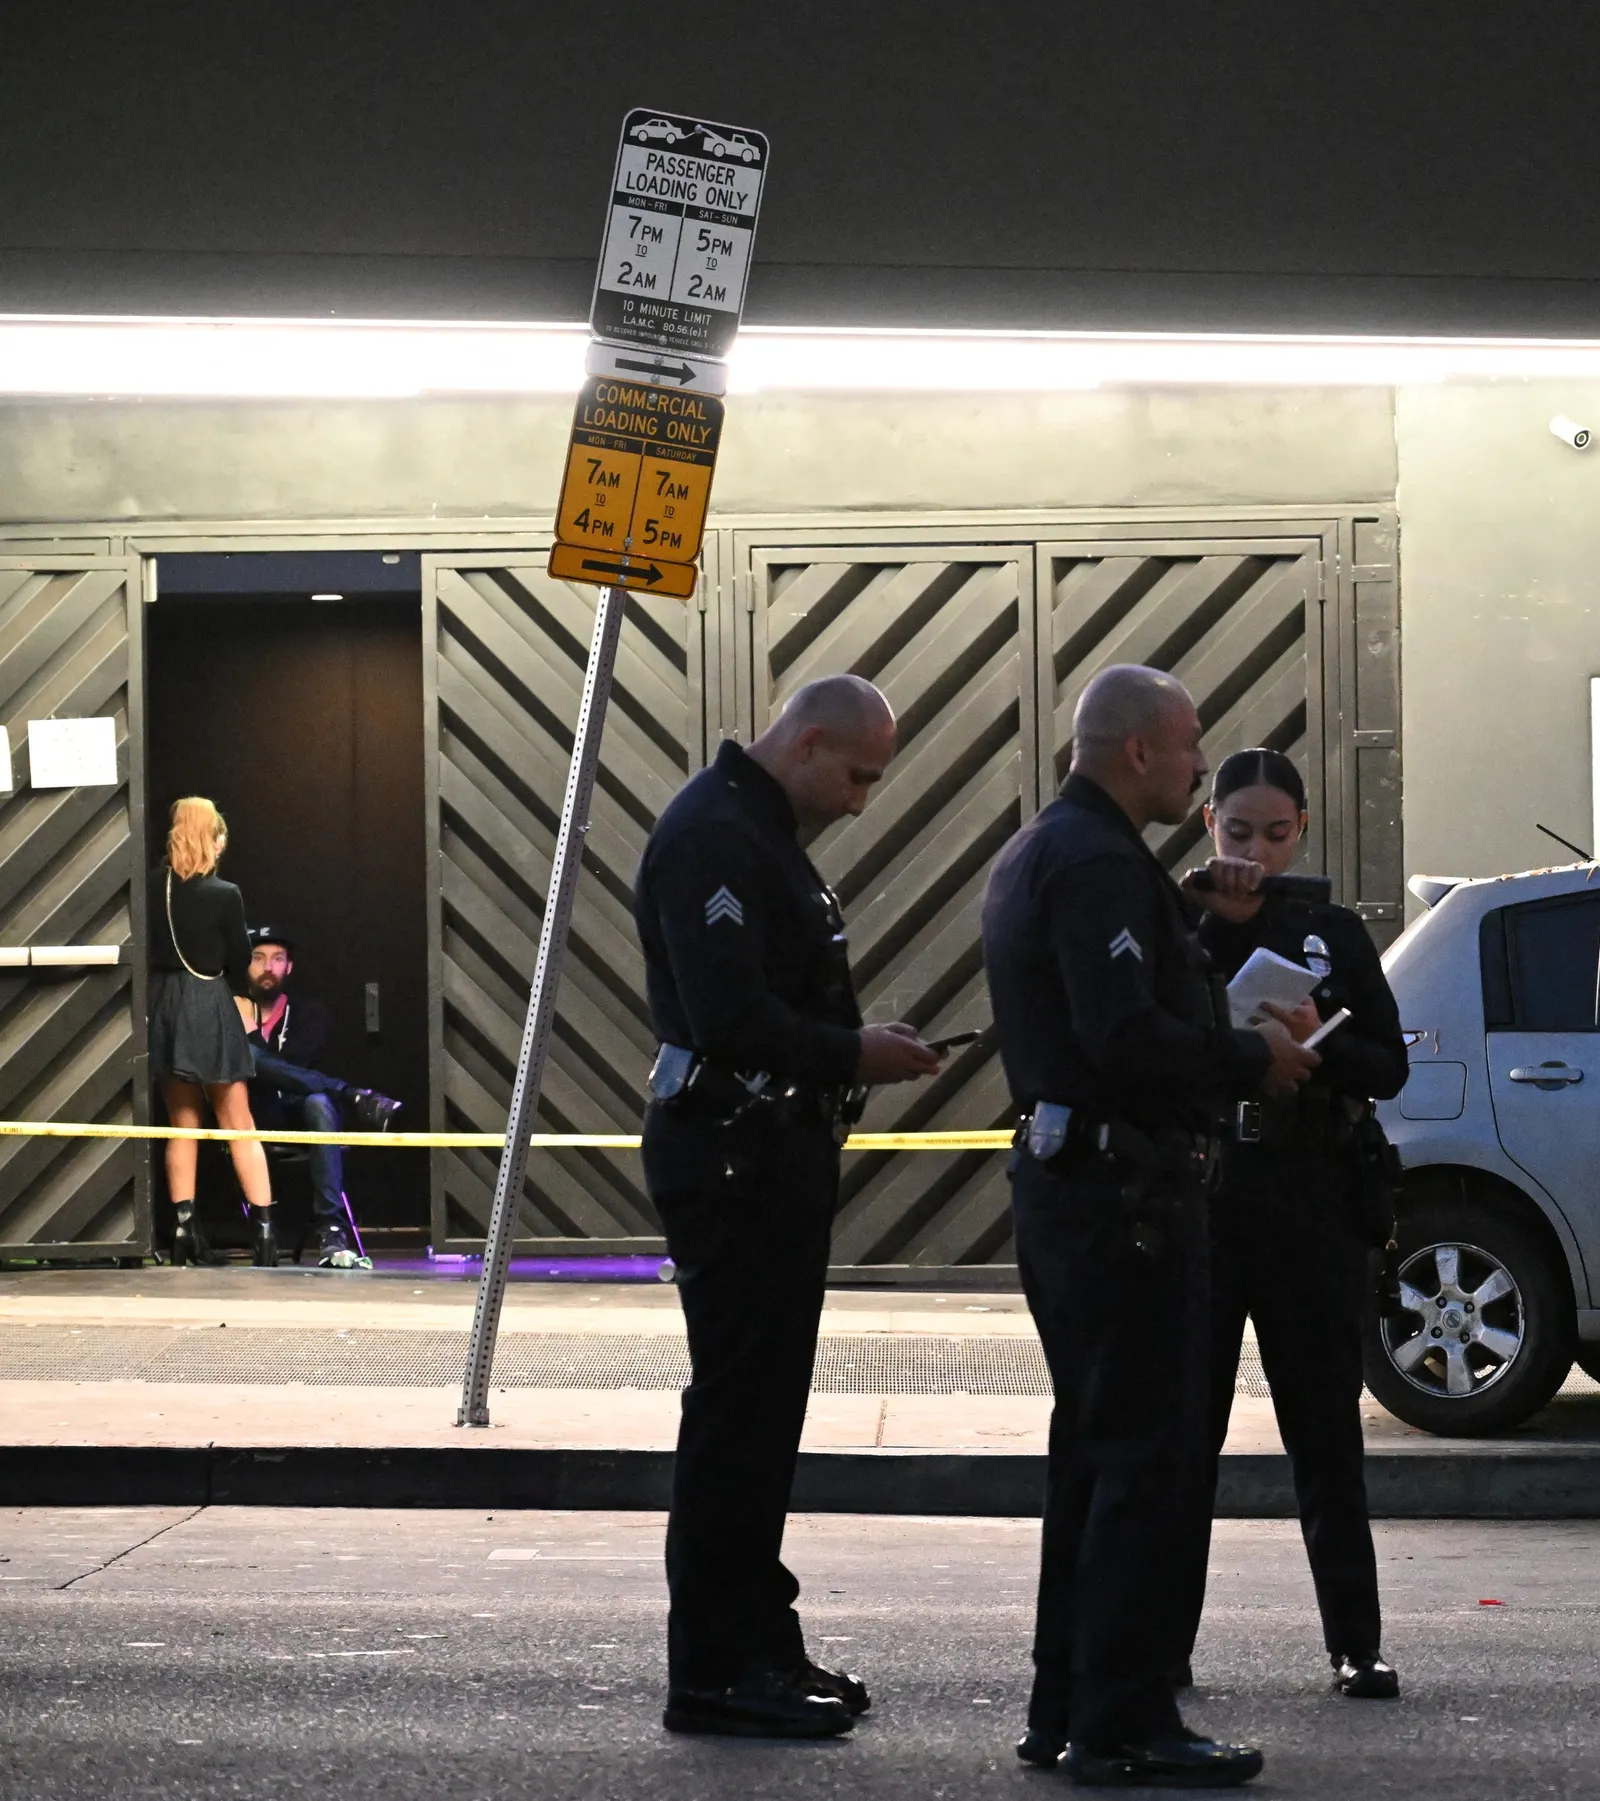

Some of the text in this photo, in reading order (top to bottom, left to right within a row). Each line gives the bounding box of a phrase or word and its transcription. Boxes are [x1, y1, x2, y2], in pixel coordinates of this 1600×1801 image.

[645, 152, 736, 187] PASSENGER
[625, 170, 749, 211] LOADING ONLY
[628, 214, 663, 244] 7PM
[696, 228, 733, 257] 5PM
[636, 244, 648, 257] TO
[706, 256, 718, 270] TO
[623, 299, 712, 326] 10 MINUTE LIMIT
[623, 315, 656, 329] L.A.M.C.
[583, 404, 712, 445] LOADING ONLY
[656, 447, 698, 461] SATURDAY
[586, 457, 621, 488] 7AM
[656, 470, 690, 500] 7AM
[595, 493, 607, 506] TO
[664, 504, 675, 518] TO
